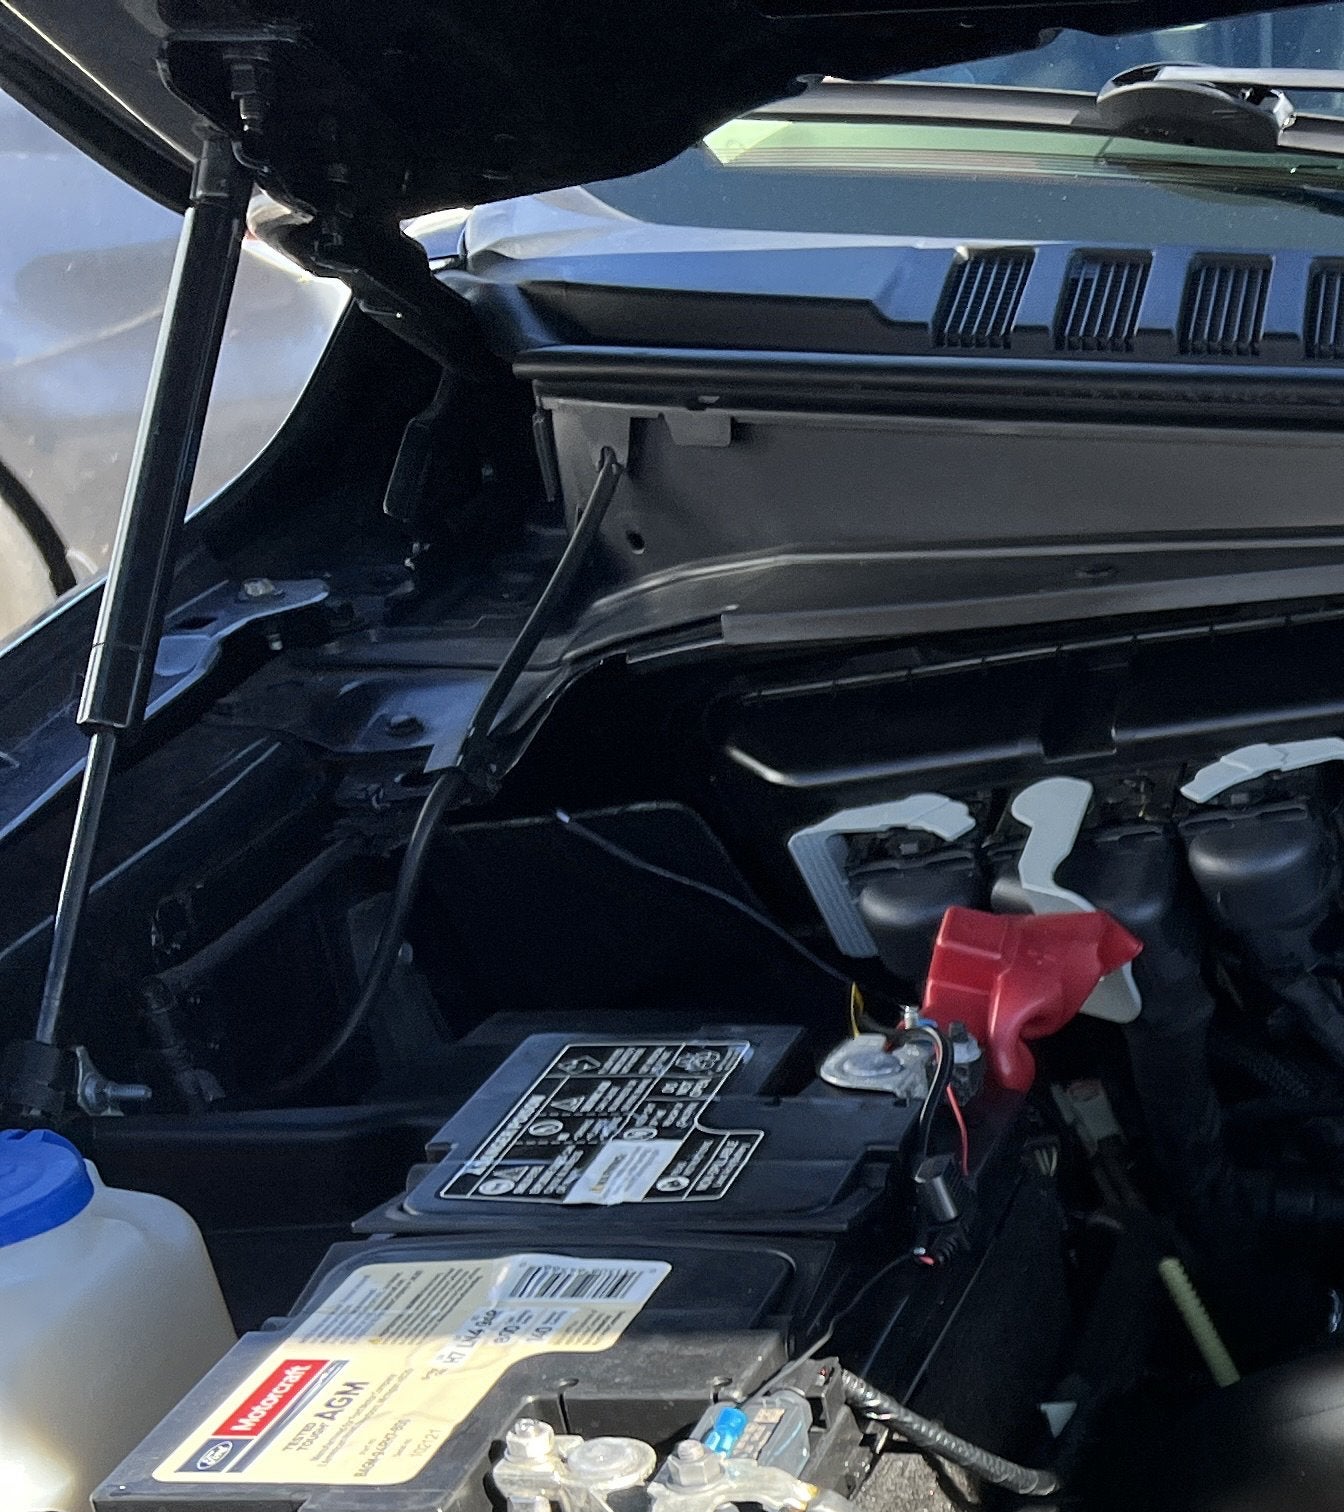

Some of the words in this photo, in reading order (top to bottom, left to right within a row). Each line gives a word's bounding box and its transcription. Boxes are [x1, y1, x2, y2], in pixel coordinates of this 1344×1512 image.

[230, 1364, 311, 1432] Motorcraft
[314, 1381, 370, 1422] AGM
[282, 1421, 317, 1451] TESTED
